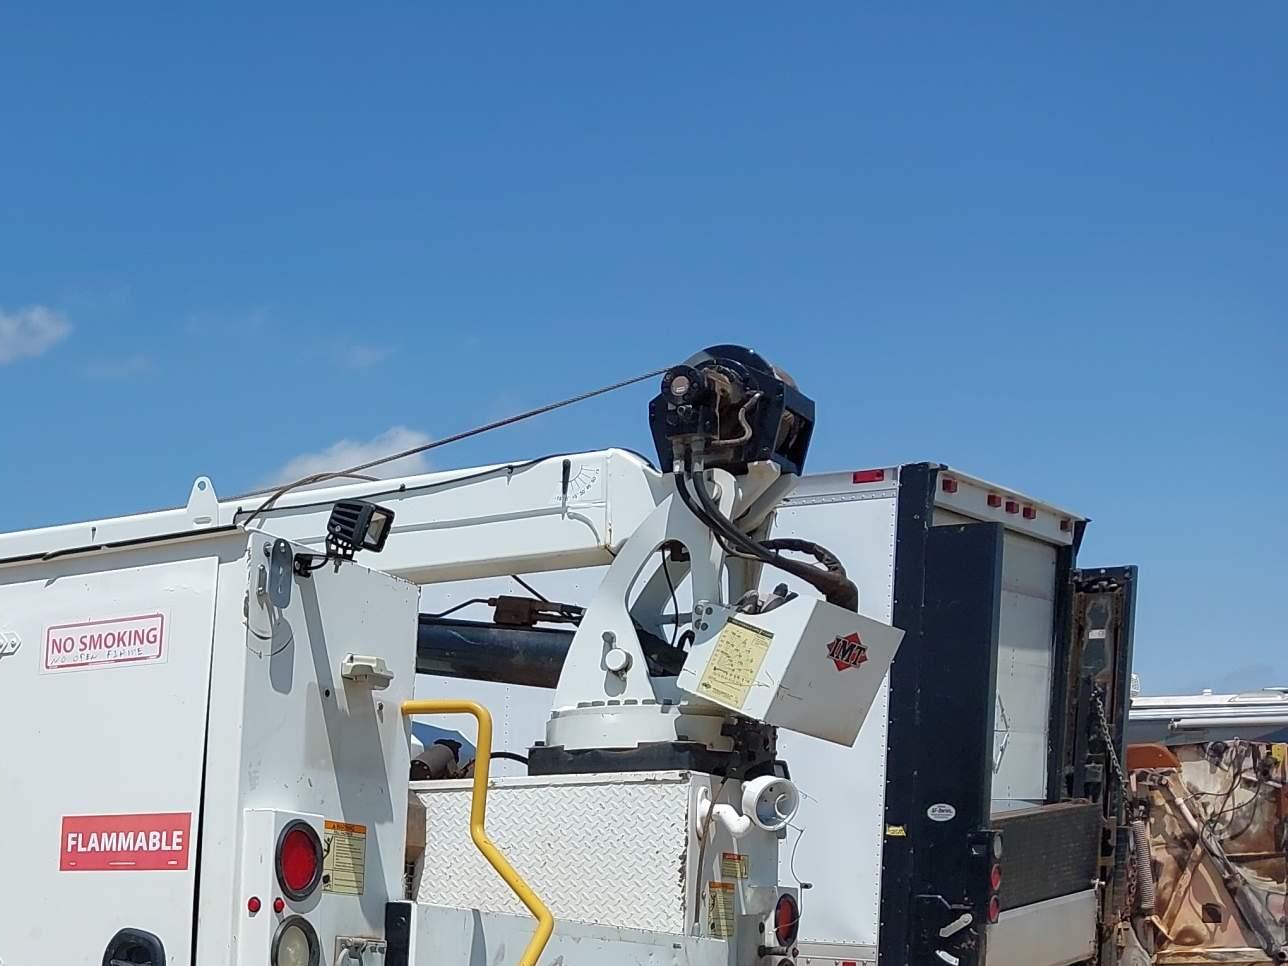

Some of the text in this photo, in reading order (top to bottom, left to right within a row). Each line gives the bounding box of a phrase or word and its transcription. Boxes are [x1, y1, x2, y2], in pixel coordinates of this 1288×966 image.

[51, 627, 158, 655] NO SMOKING
[828, 635, 867, 667] IMT
[67, 830, 183, 853] FLAMMABLE
